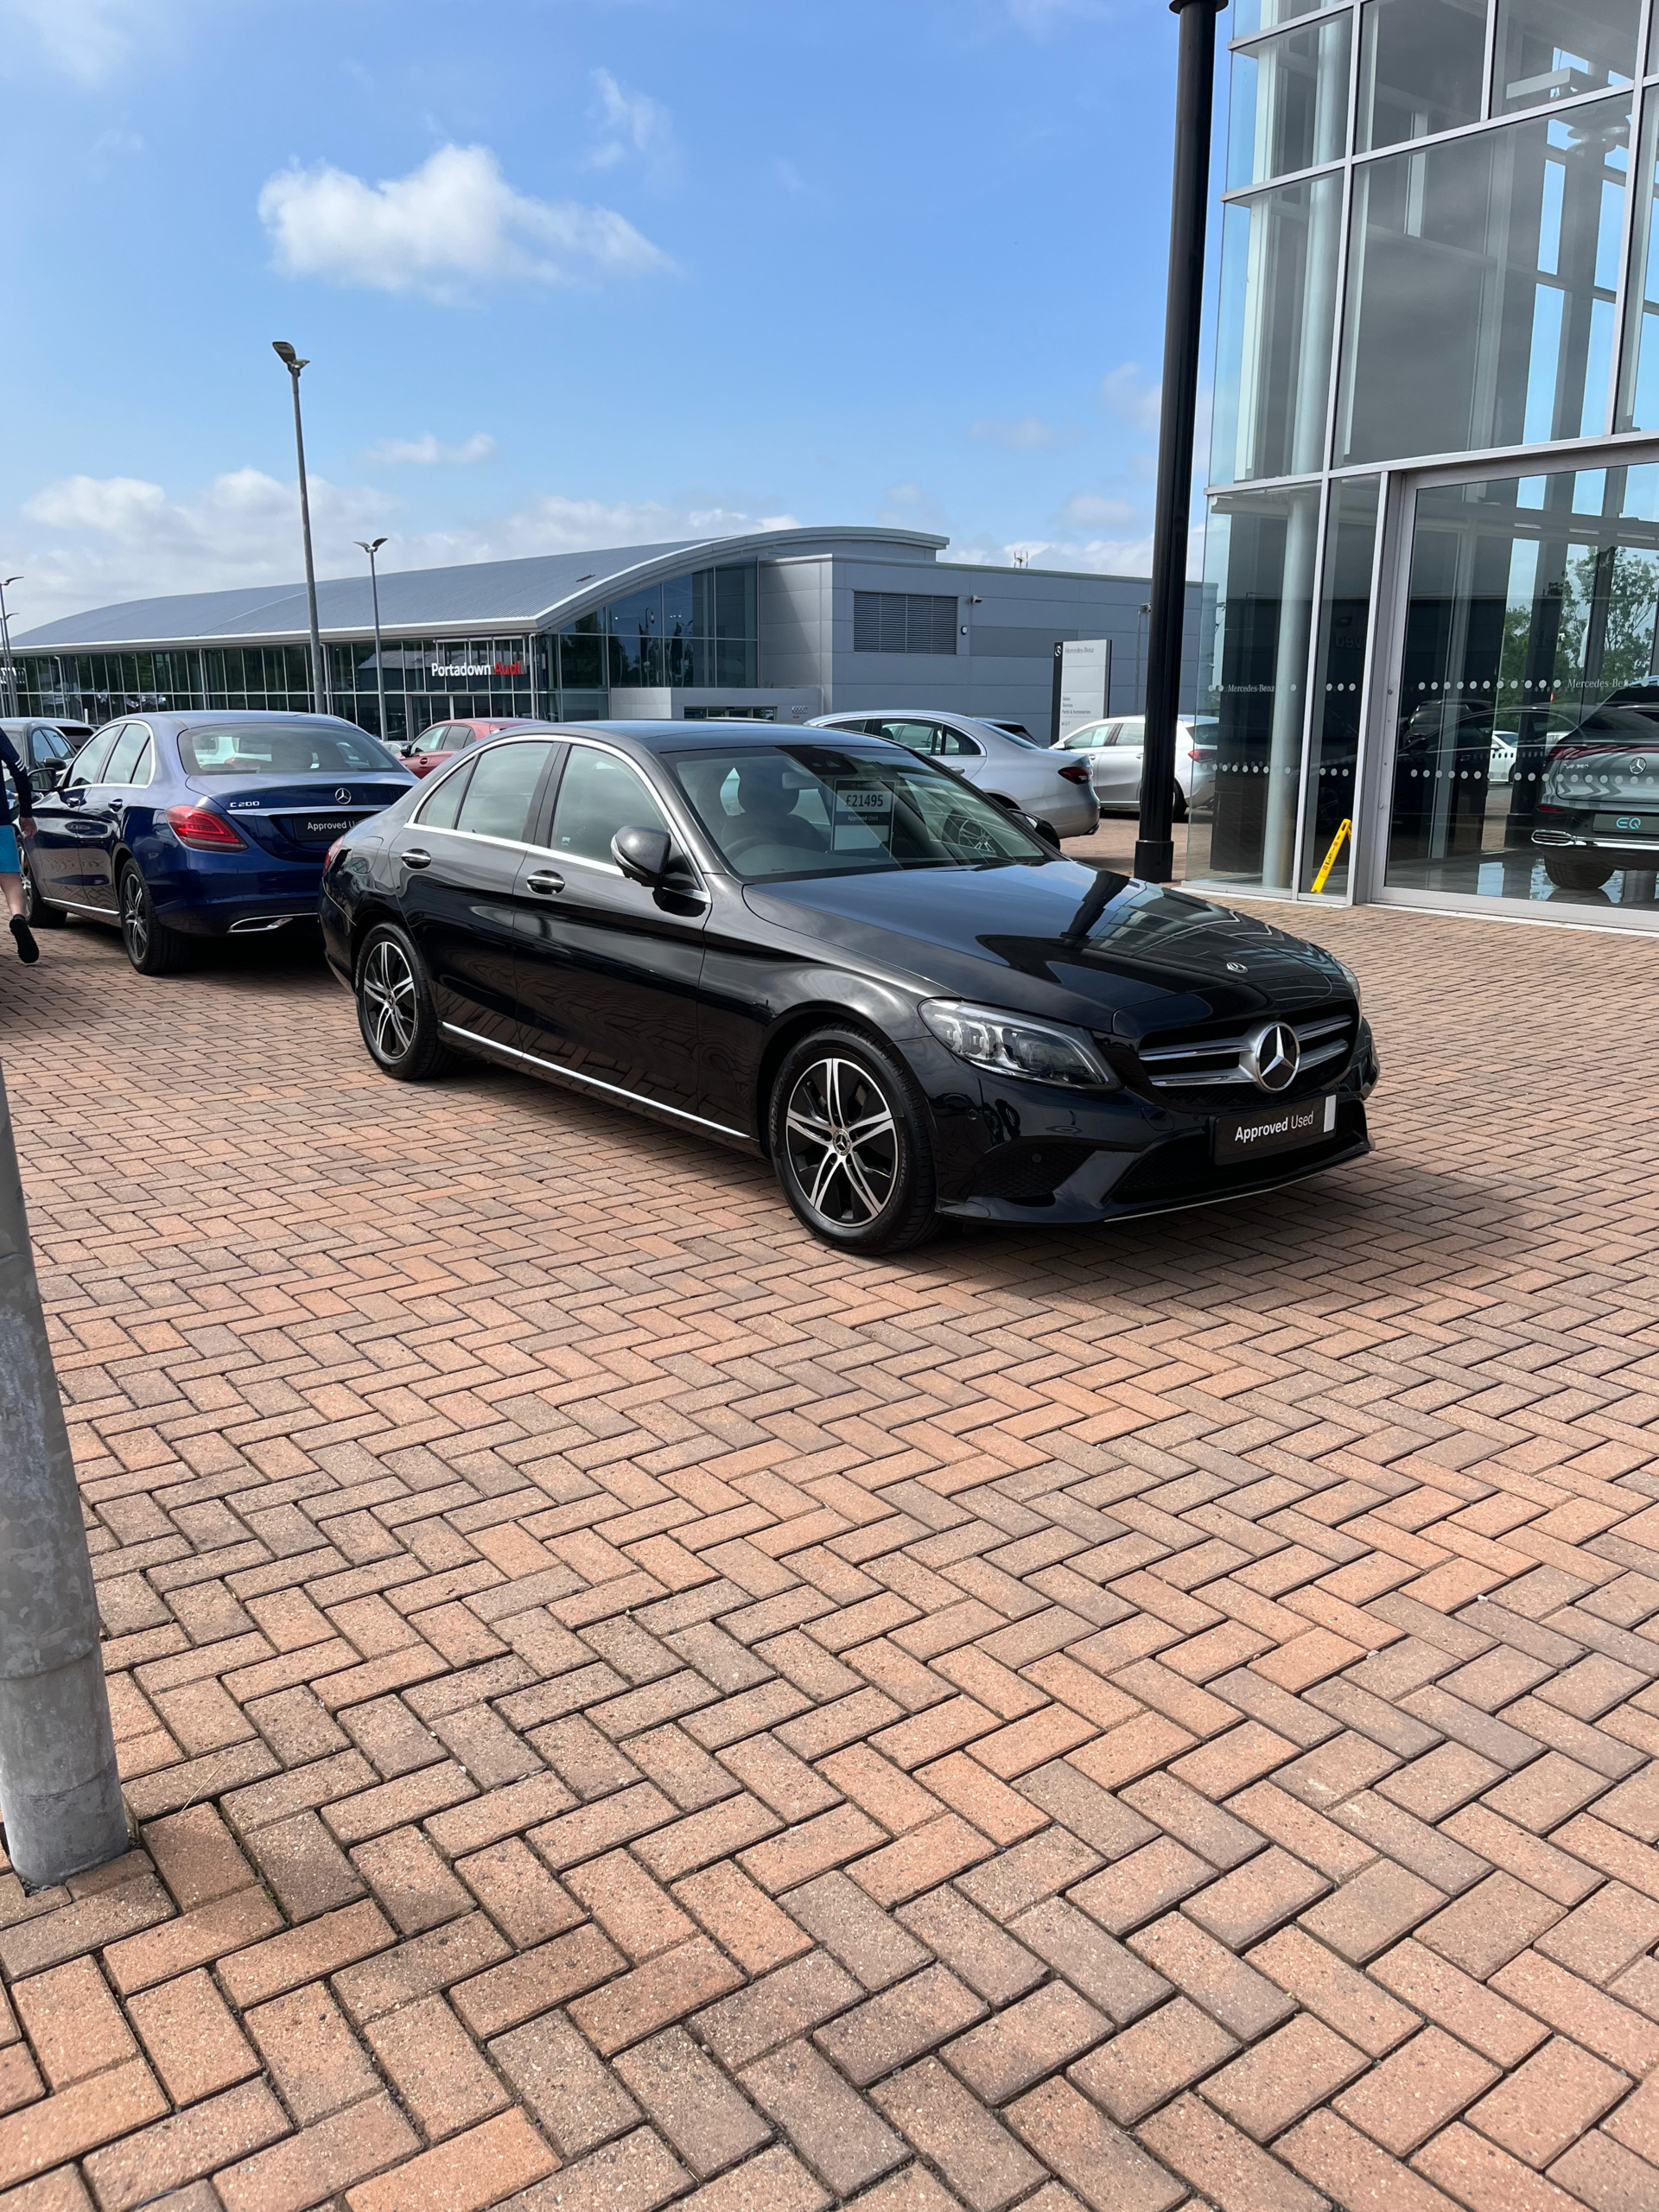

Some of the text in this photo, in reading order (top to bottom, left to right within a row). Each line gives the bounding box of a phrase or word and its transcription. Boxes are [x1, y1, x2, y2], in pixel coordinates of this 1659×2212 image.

[431, 661, 521, 677] Portadown Audi
[1228, 683, 1274, 692] Mercedes-Benz
[1567, 678, 1634, 688] Mercedes-Be
[845, 794, 883, 807] £21495
[307, 821, 346, 831] Approved
[1617, 817, 1641, 830] EQ
[1235, 1109, 1313, 1143] Approved Used
